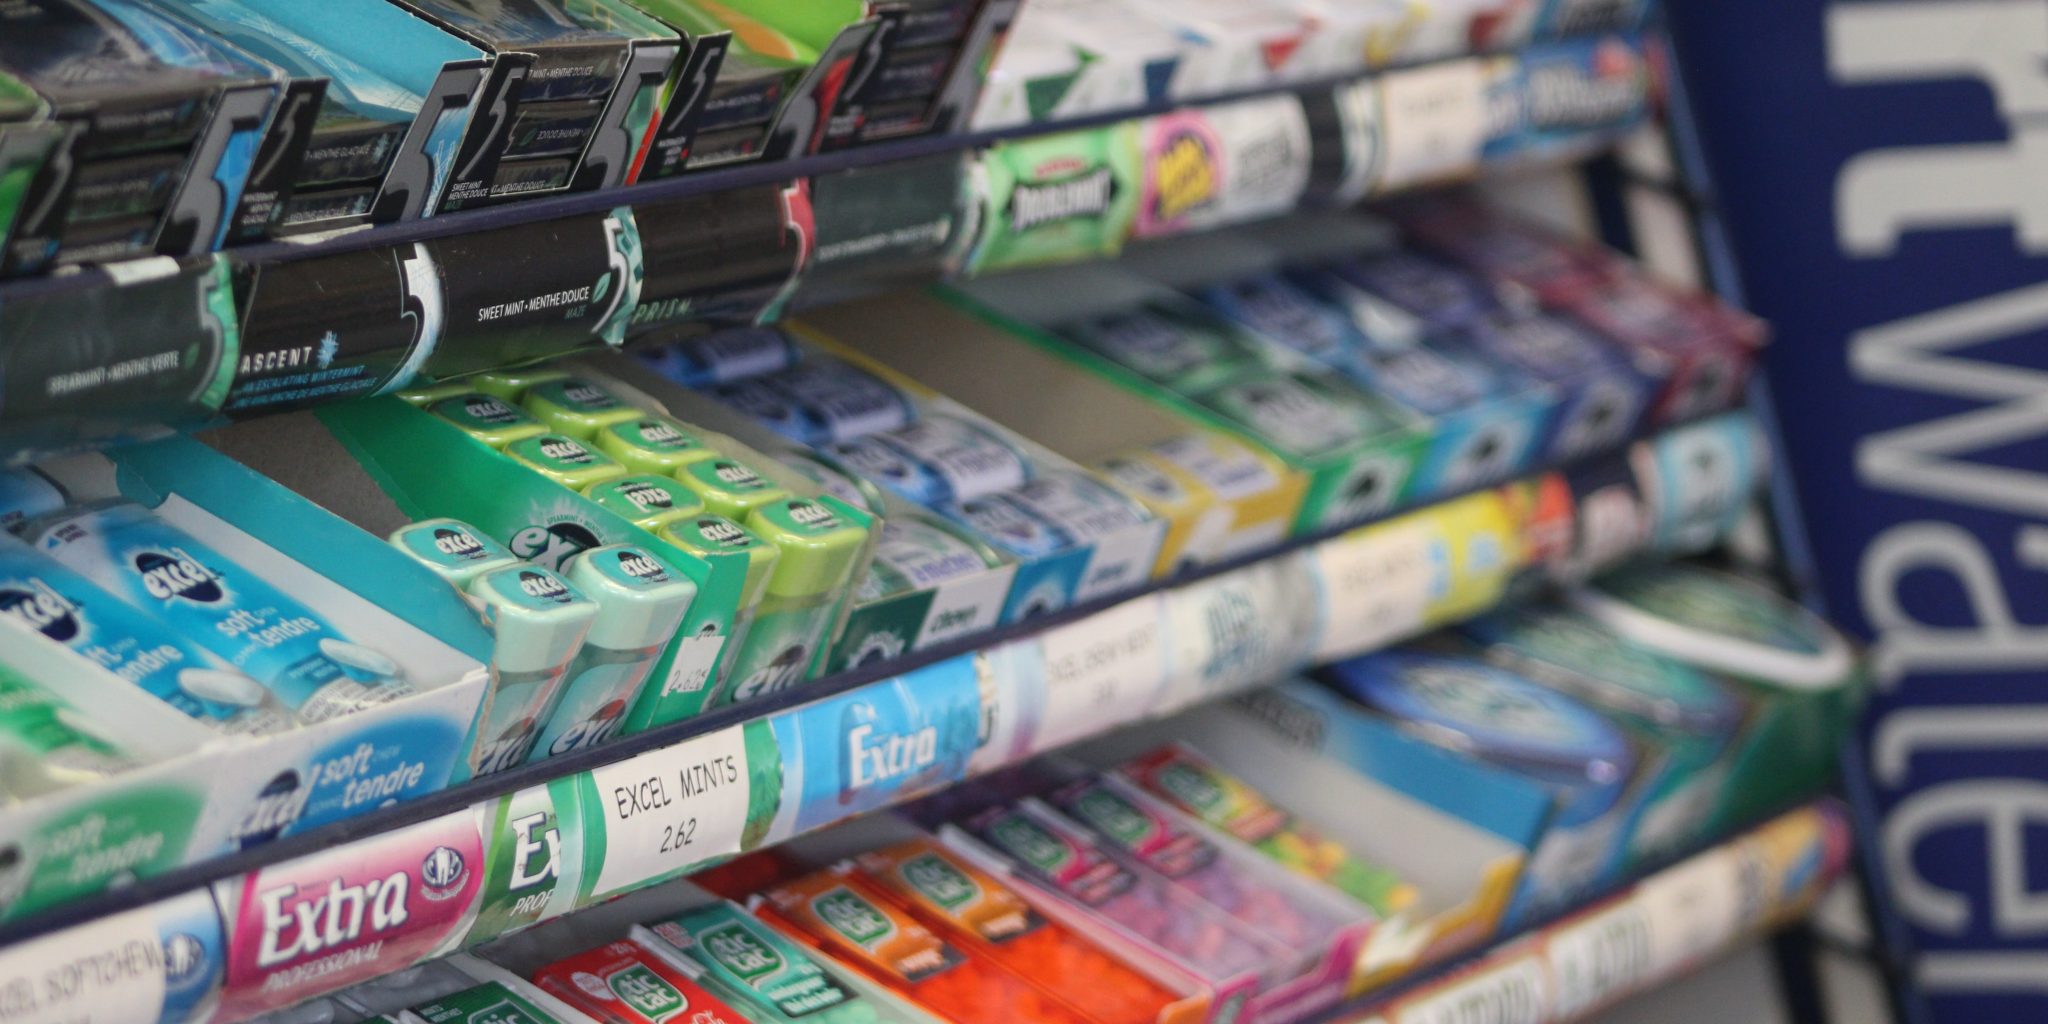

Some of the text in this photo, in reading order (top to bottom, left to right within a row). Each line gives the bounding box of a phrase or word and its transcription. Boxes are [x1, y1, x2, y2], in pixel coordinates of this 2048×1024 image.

[478, 286, 591, 322] SWEET MINT MENTHE DOUCE
[632, 298, 691, 325] PRISM
[240, 346, 312, 374] ASCENT
[435, 525, 484, 555] excel
[700, 517, 745, 541] excel
[142, 545, 215, 600] excel
[619, 547, 665, 577] excel
[520, 568, 568, 597] excel
[216, 609, 266, 638] soft
[247, 615, 321, 648] tendre
[321, 742, 374, 785] soft
[849, 724, 938, 789] Extra
[342, 761, 425, 809] tendre
[615, 754, 738, 820] EXCEL MINTS
[659, 817, 697, 854] 2.62
[258, 870, 409, 968] Extra
[709, 929, 756, 955] tic
[262, 940, 385, 993] PROFESSIONAL
[724, 950, 778, 973] tac
[618, 973, 660, 999] tic
[629, 987, 679, 1011] tac
